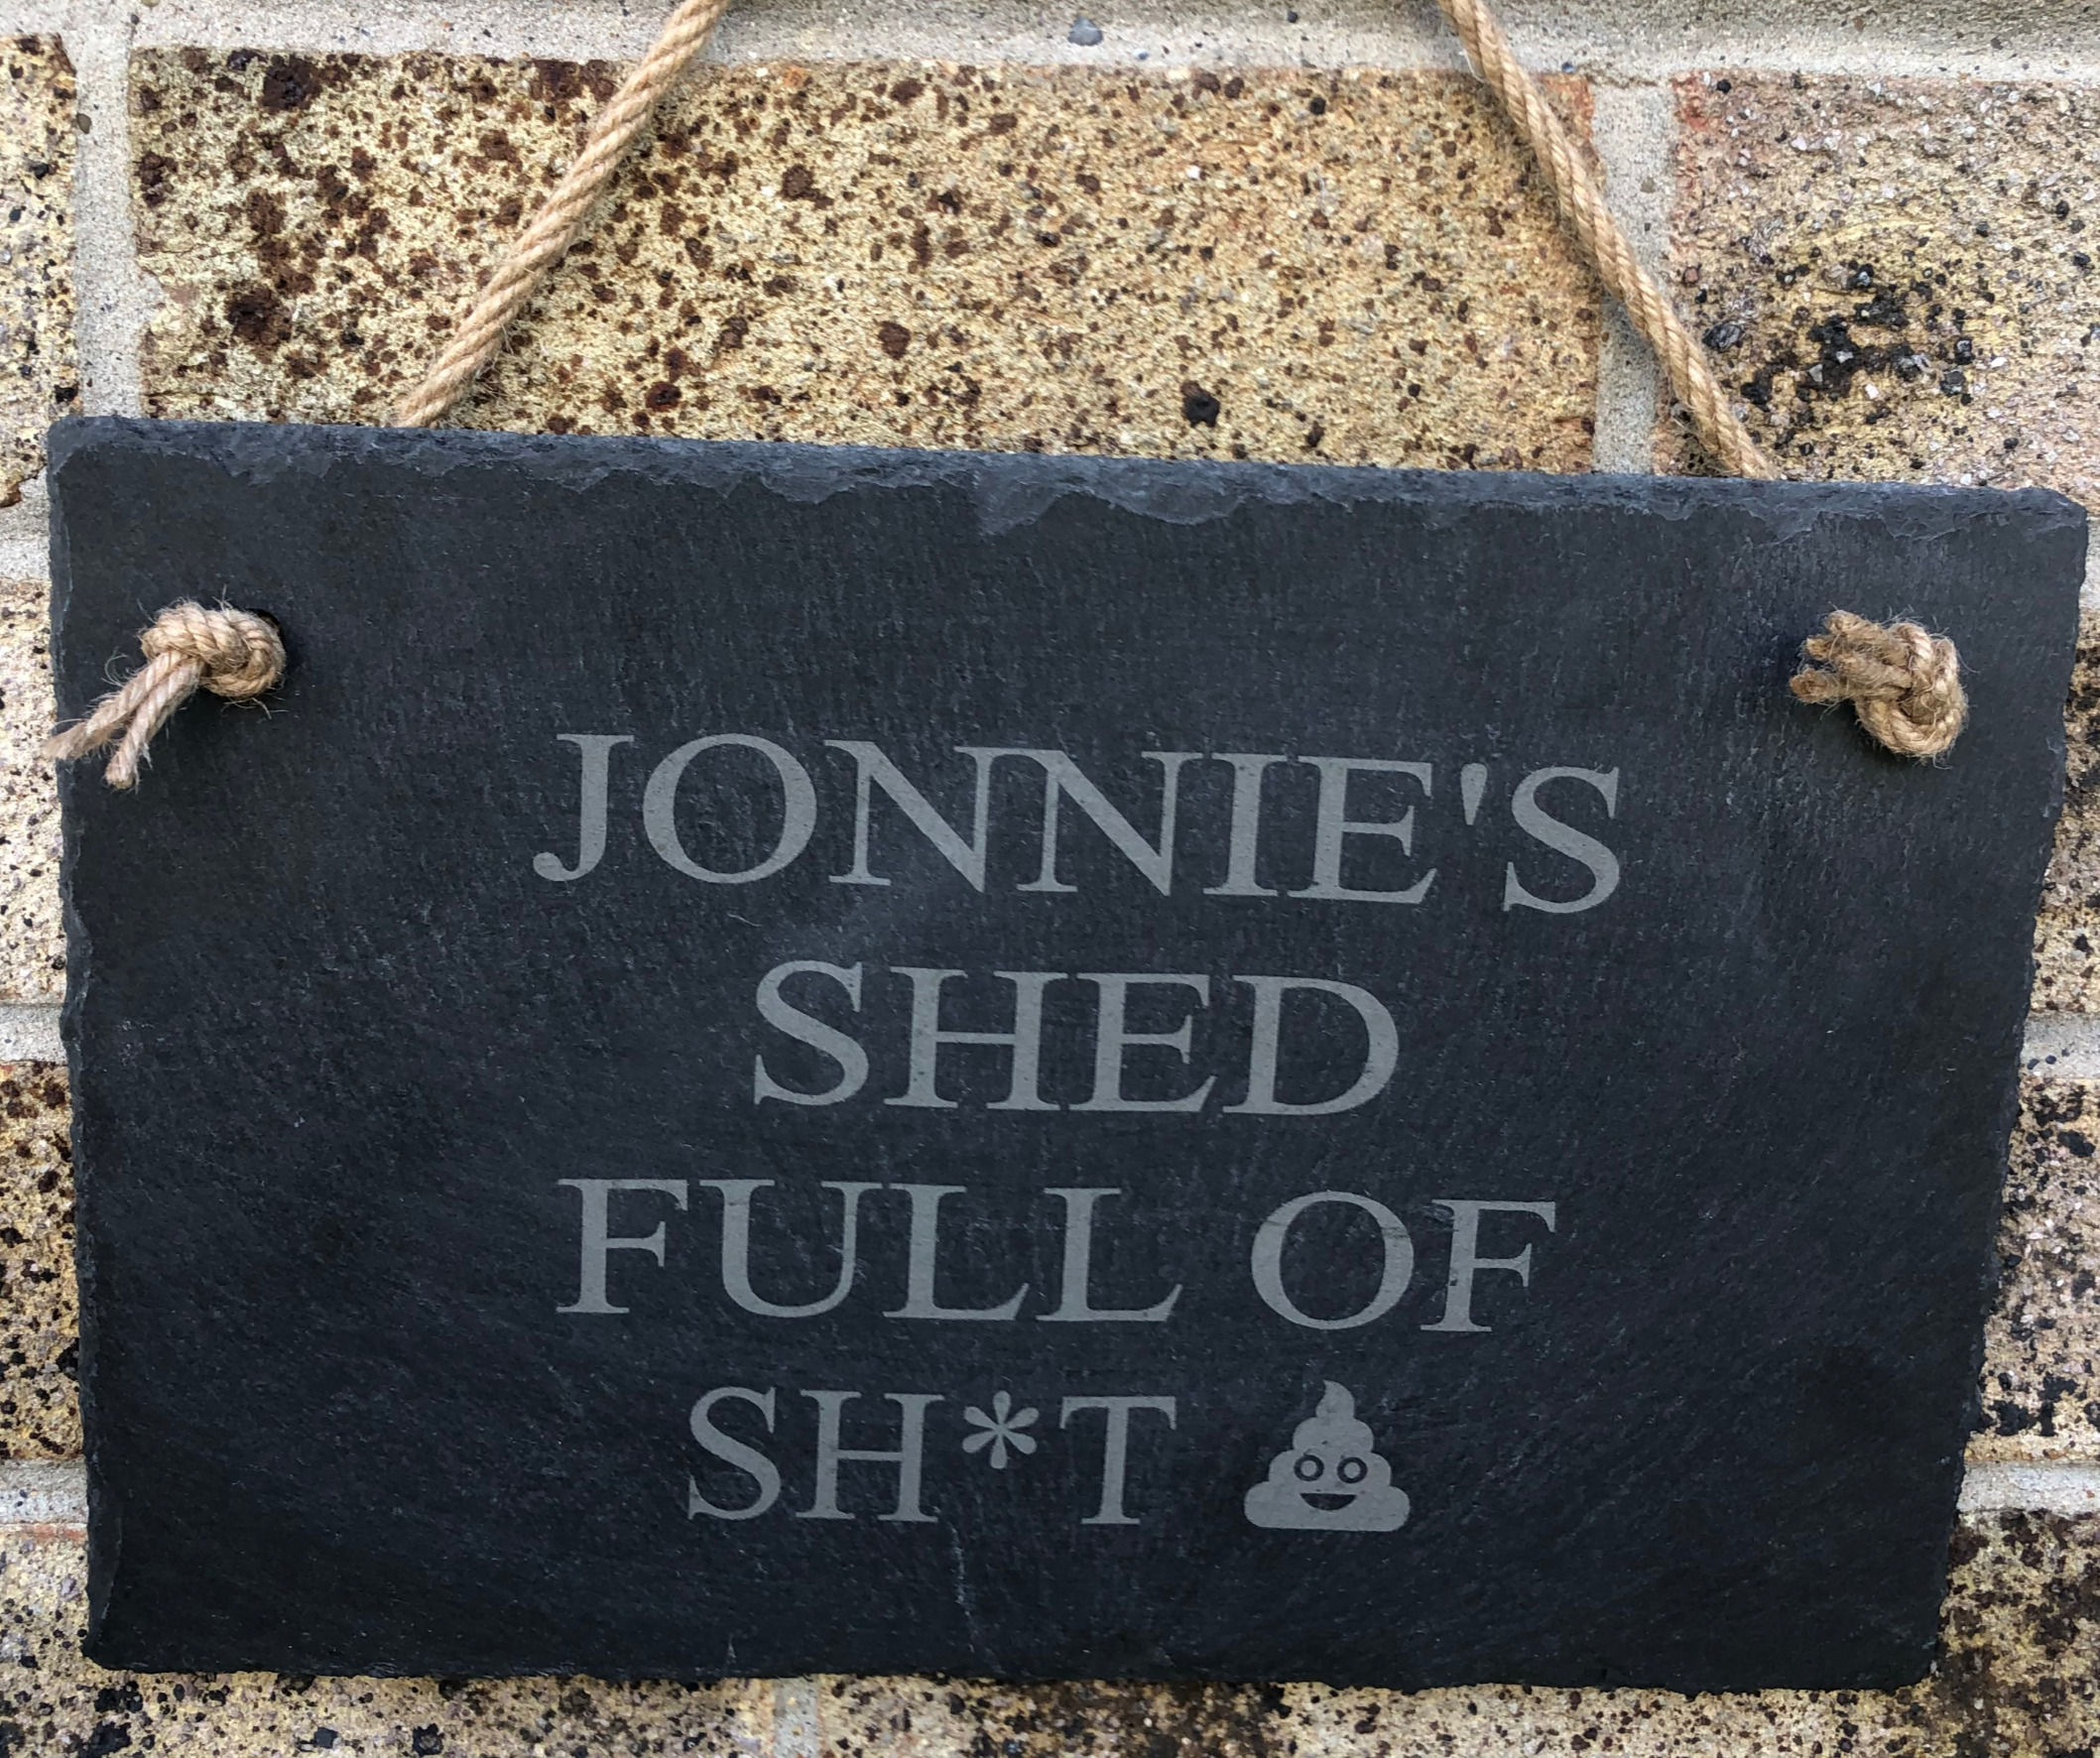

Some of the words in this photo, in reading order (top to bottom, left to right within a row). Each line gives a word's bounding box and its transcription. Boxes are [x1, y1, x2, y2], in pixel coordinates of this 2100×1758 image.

[533, 732, 1622, 914] JONNIE'S
[753, 959, 1400, 1116] SHED
[556, 1178, 1183, 1322] FULL
[1250, 1190, 1557, 1332] OF
